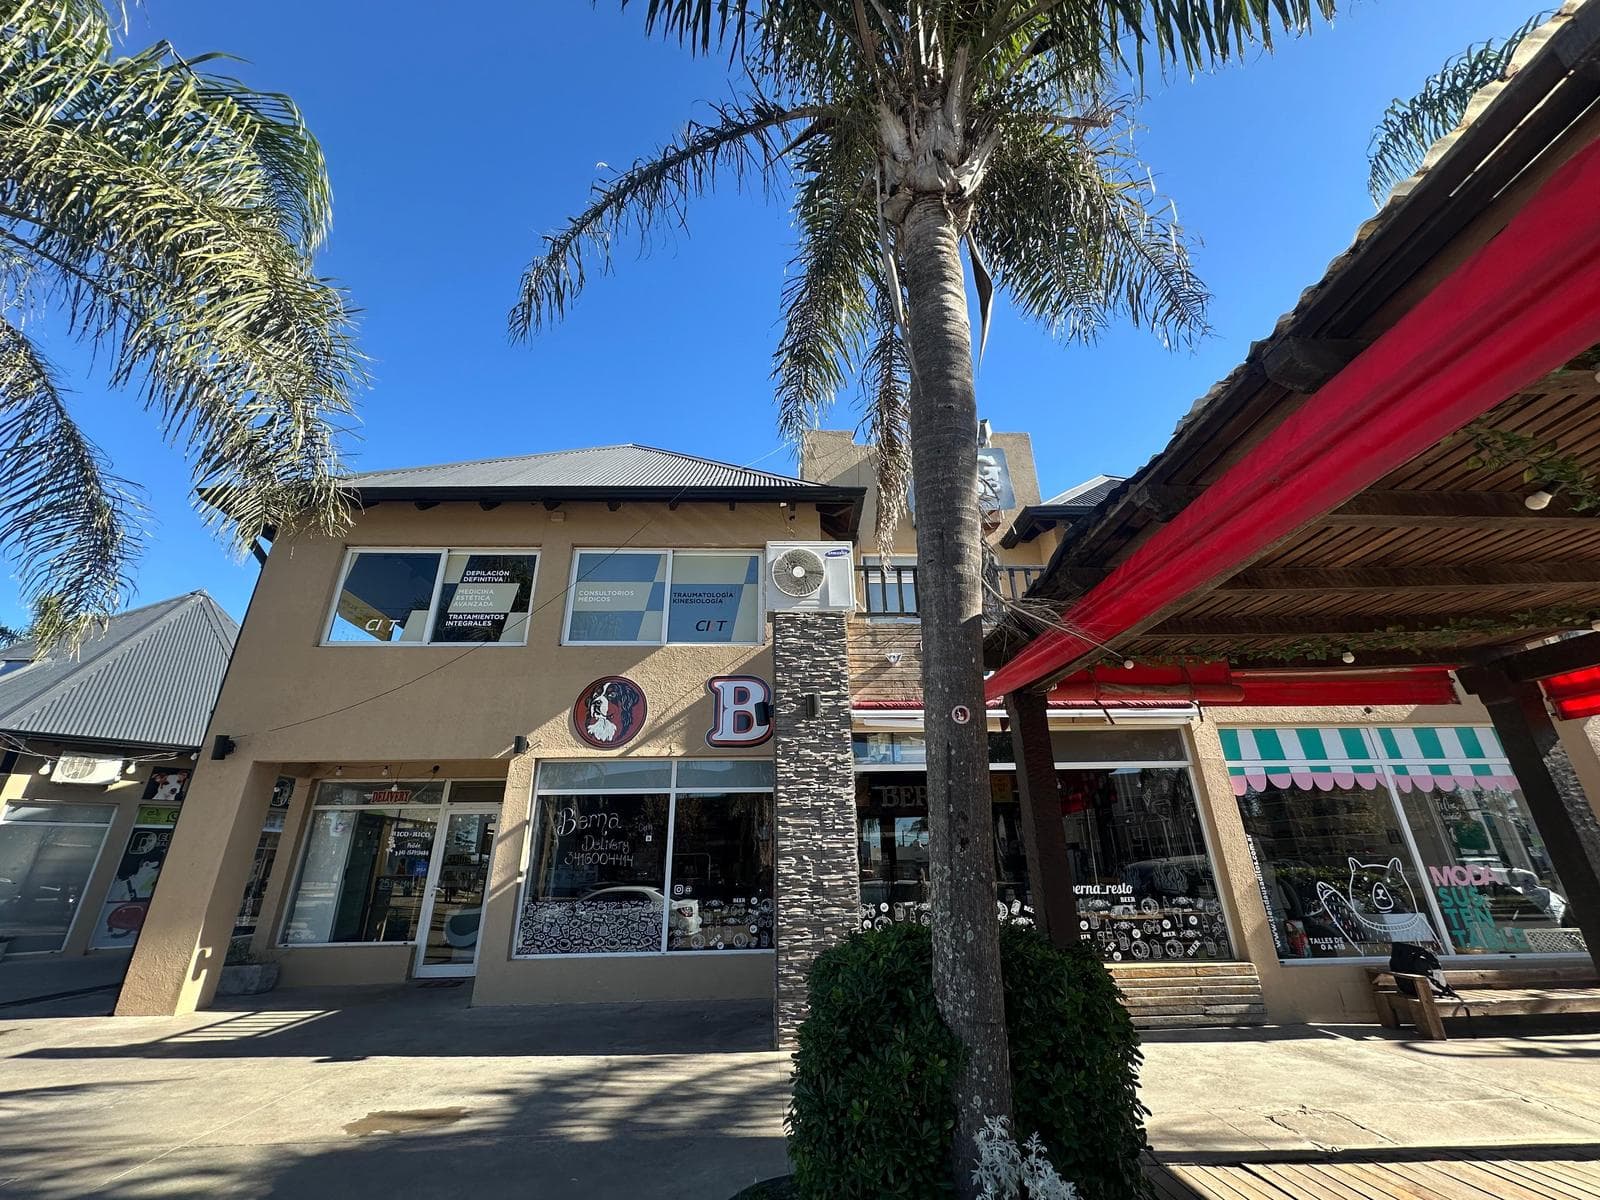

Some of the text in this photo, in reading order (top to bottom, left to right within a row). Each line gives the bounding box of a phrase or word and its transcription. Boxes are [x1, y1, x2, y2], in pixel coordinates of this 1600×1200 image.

[704, 675, 775, 748] B
[372, 791, 410, 802] DELIVERY
[880, 785, 928, 807] BER
[557, 807, 622, 836] Berna
[1429, 865, 1504, 887] MODA
[1438, 886, 1485, 907] SUS
[1444, 908, 1496, 929] TEN
[1187, 940, 1201, 957] BEER
